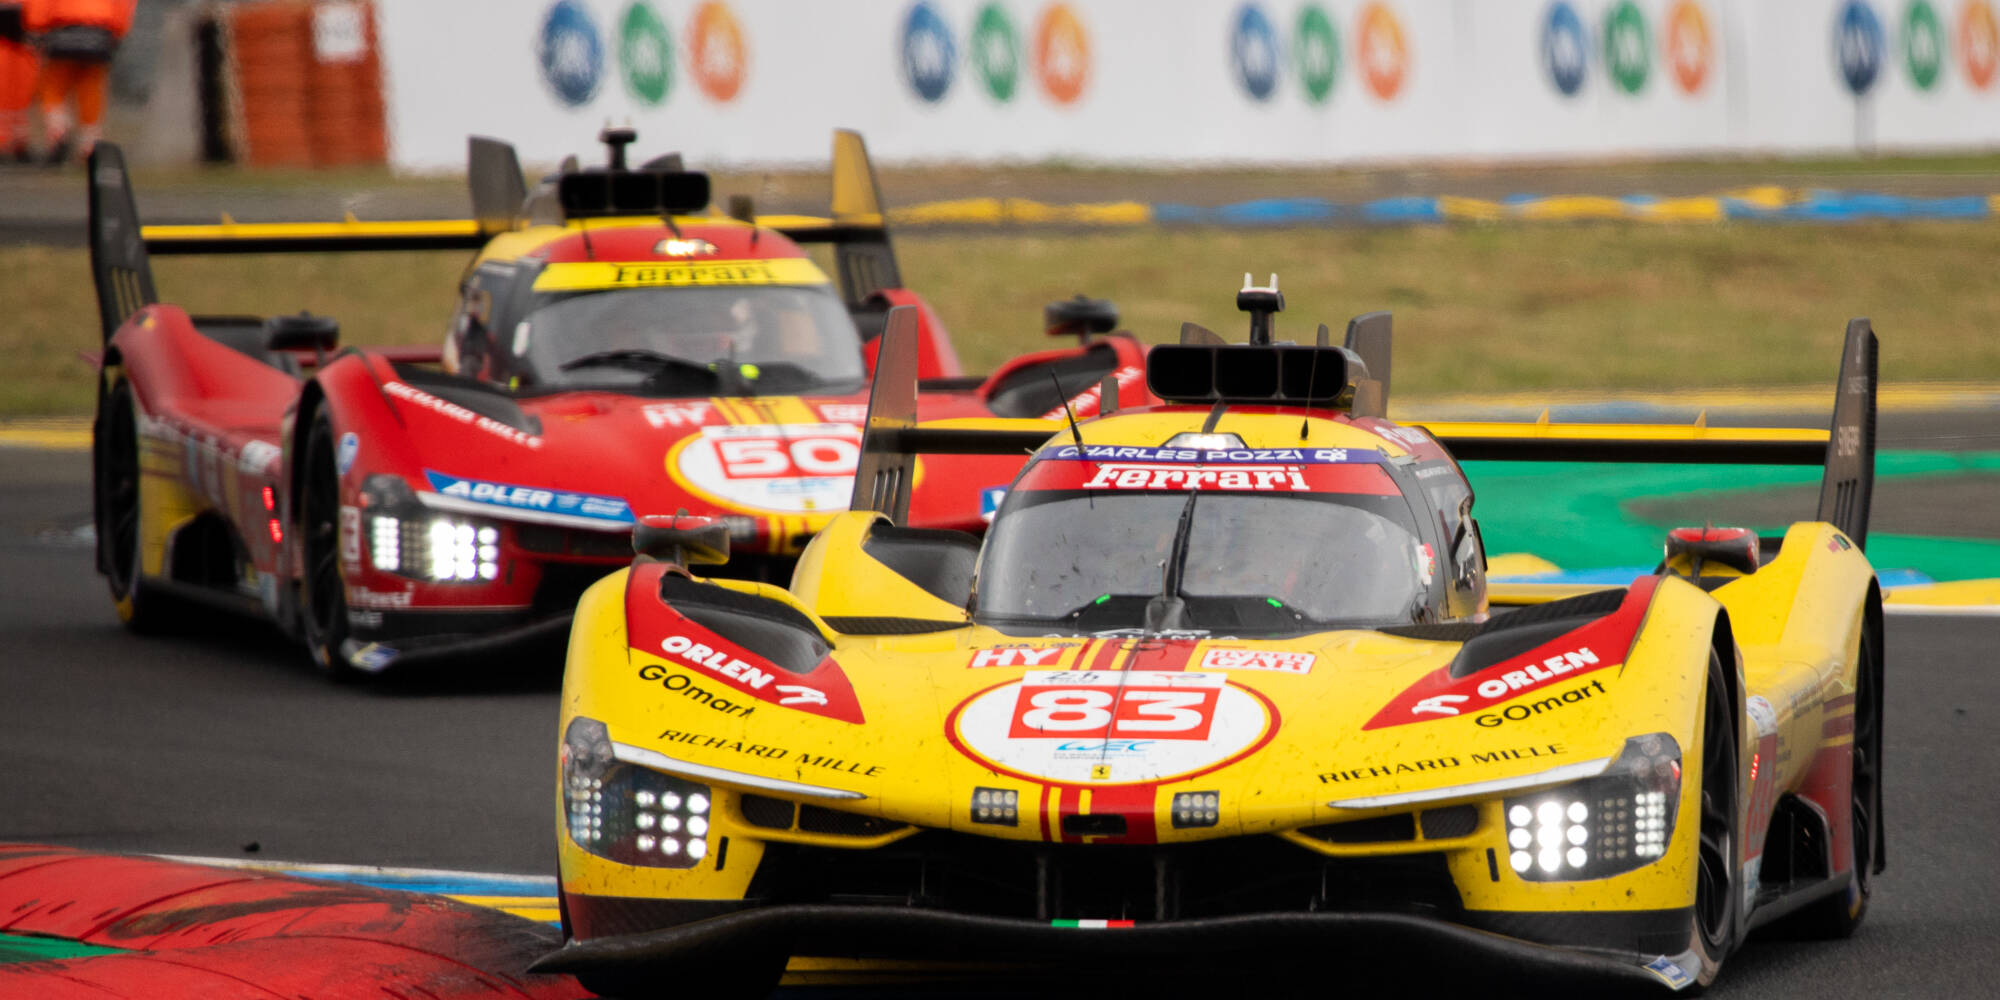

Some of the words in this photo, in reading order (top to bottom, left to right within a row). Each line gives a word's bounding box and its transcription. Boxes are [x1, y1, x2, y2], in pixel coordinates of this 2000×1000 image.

[609, 261, 777, 286] Ferrari
[384, 381, 476, 423] RICHARD
[477, 416, 543, 448] MILLE
[642, 402, 712, 428] HY
[720, 438, 861, 475] 50
[1058, 446, 1197, 460] CHARLES
[1206, 449, 1303, 461] POZZI
[442, 481, 553, 508] ADLER
[1083, 463, 1310, 490] Ferrari
[661, 636, 775, 690] ORLEN
[972, 648, 1051, 668] HY
[1209, 657, 1303, 671] CAR
[1213, 650, 1307, 662] HYPER
[1477, 647, 1600, 698] ORLEN
[638, 664, 756, 718] GOmart
[1475, 679, 1606, 727] GOmart
[1022, 689, 1203, 731] 83
[658, 729, 788, 760] RICHARD
[796, 753, 886, 778] MILLE
[1318, 756, 1460, 784] RICHARD
[1471, 743, 1567, 764] MILLE
